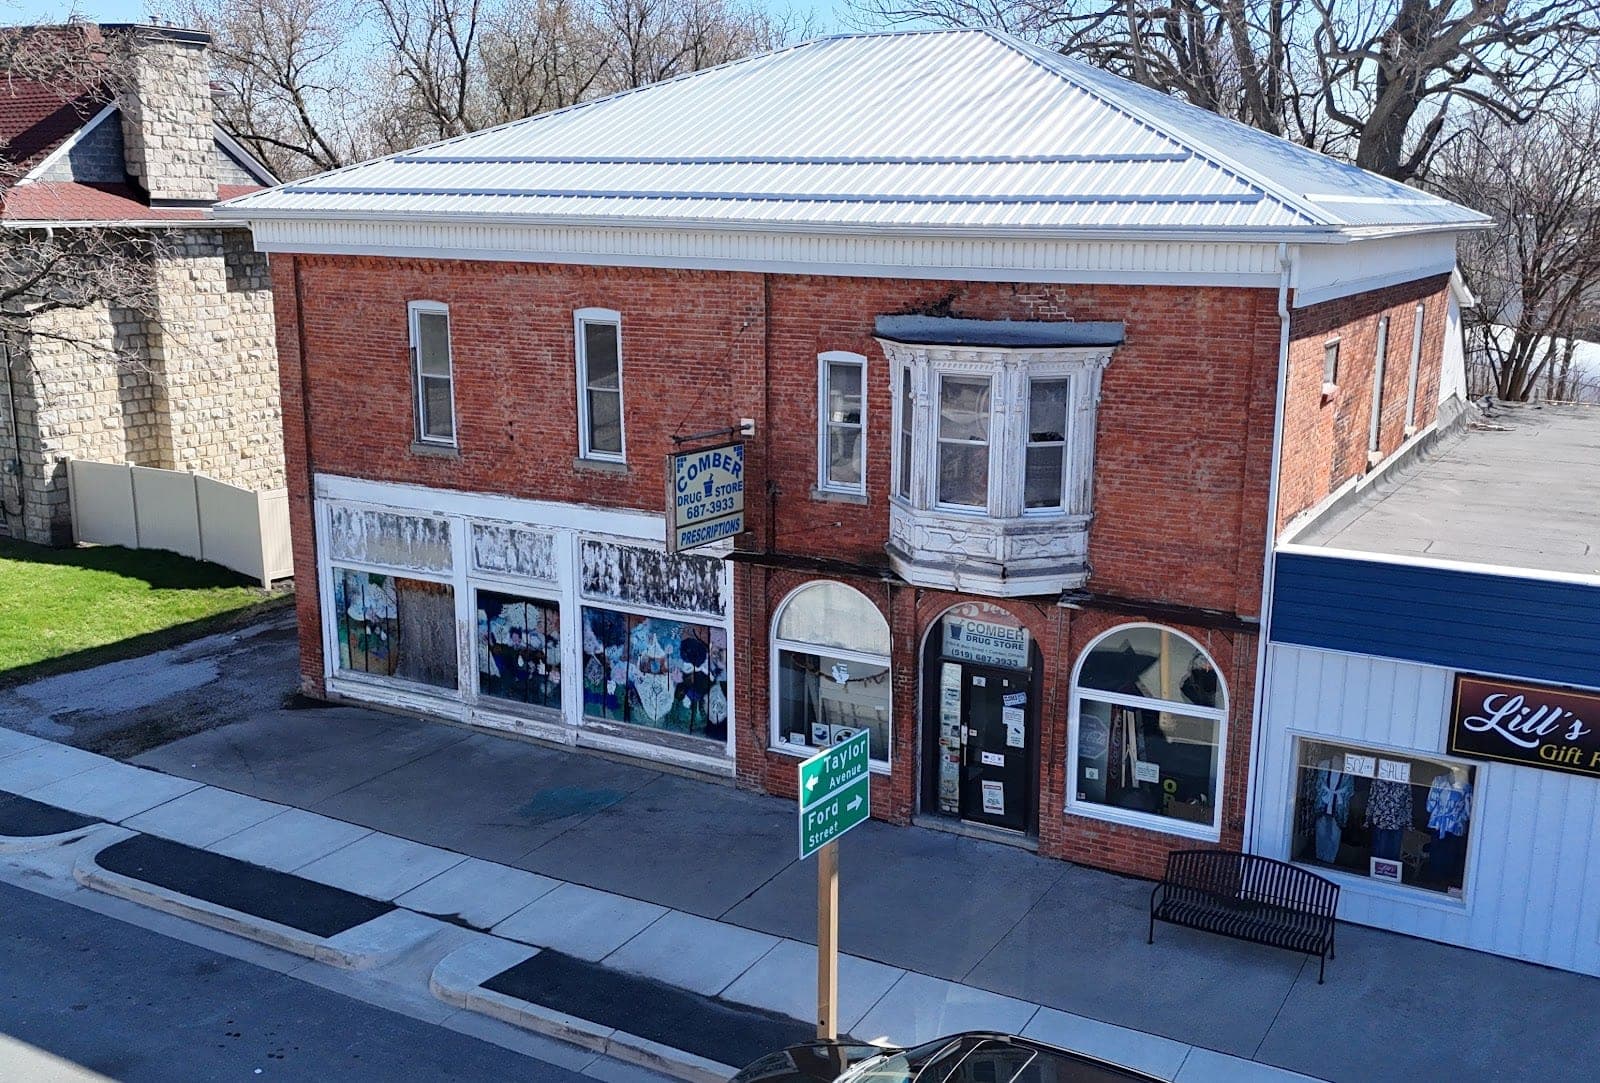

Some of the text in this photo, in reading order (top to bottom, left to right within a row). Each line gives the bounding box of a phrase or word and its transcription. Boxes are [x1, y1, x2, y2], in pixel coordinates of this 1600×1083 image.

[677, 452, 742, 493] COMBER
[677, 480, 743, 507] DRUG STORE
[686, 497, 735, 520] 687-3933
[680, 518, 740, 546] PRESCRIPTIONS
[966, 621, 1025, 640] COMBER
[966, 635, 991, 645] DRUG
[993, 640, 1025, 651] STORE
[951, 648, 973, 660] (519)
[975, 654, 1018, 667] 687-3933
[1463, 693, 1592, 748] Lill's
[823, 740, 866, 774] Taylor
[1539, 744, 1583, 765] Gift
[829, 763, 862, 790] Avenue
[1380, 761, 1408, 781] SALE
[808, 798, 839, 831] Ford
[809, 821, 838, 848] Street
